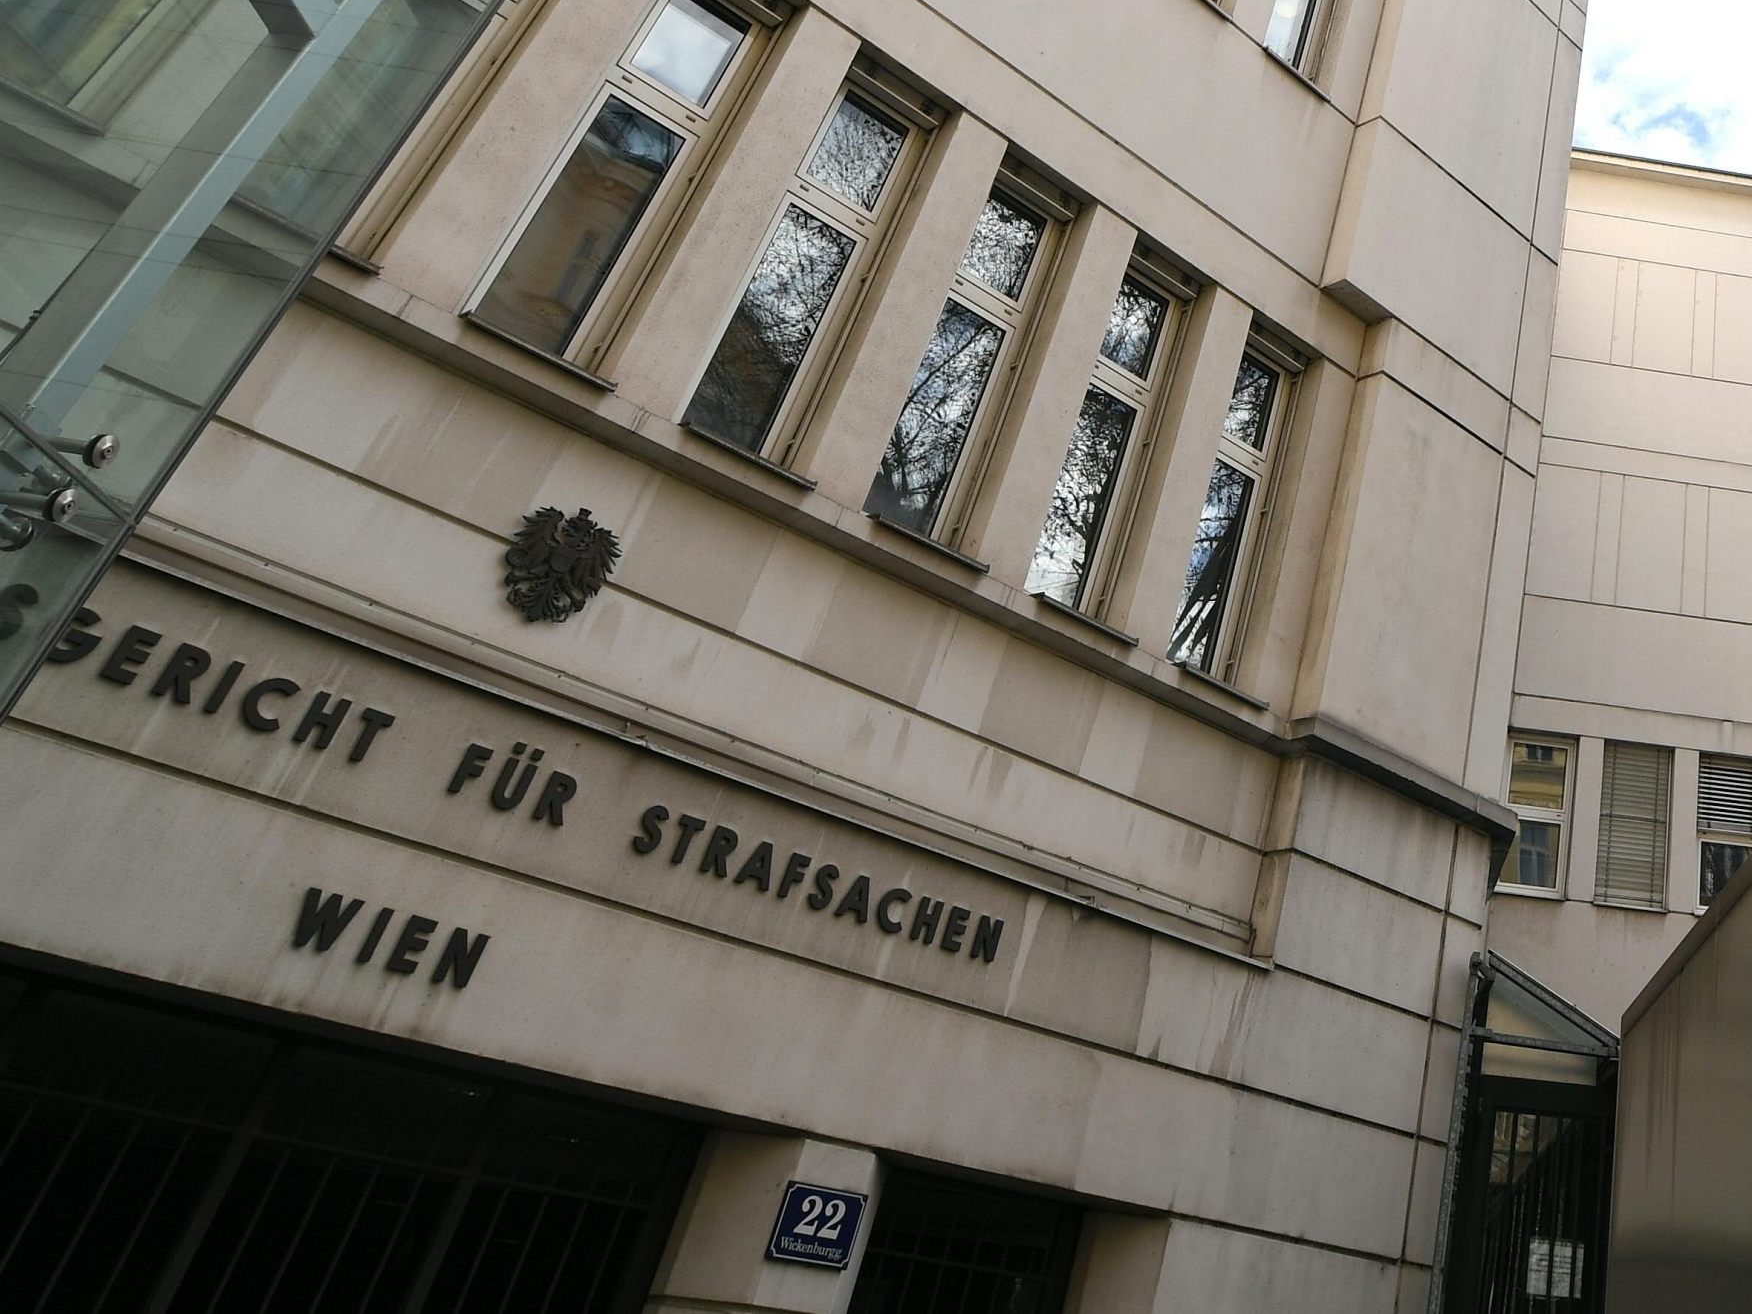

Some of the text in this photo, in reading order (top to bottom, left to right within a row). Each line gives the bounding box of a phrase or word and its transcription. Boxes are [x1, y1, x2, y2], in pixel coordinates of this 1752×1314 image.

[448, 742, 577, 826] FÜR
[633, 805, 1004, 962] STRAFSACHEN
[295, 887, 492, 989] WIEN
[793, 1195, 846, 1240] 22
